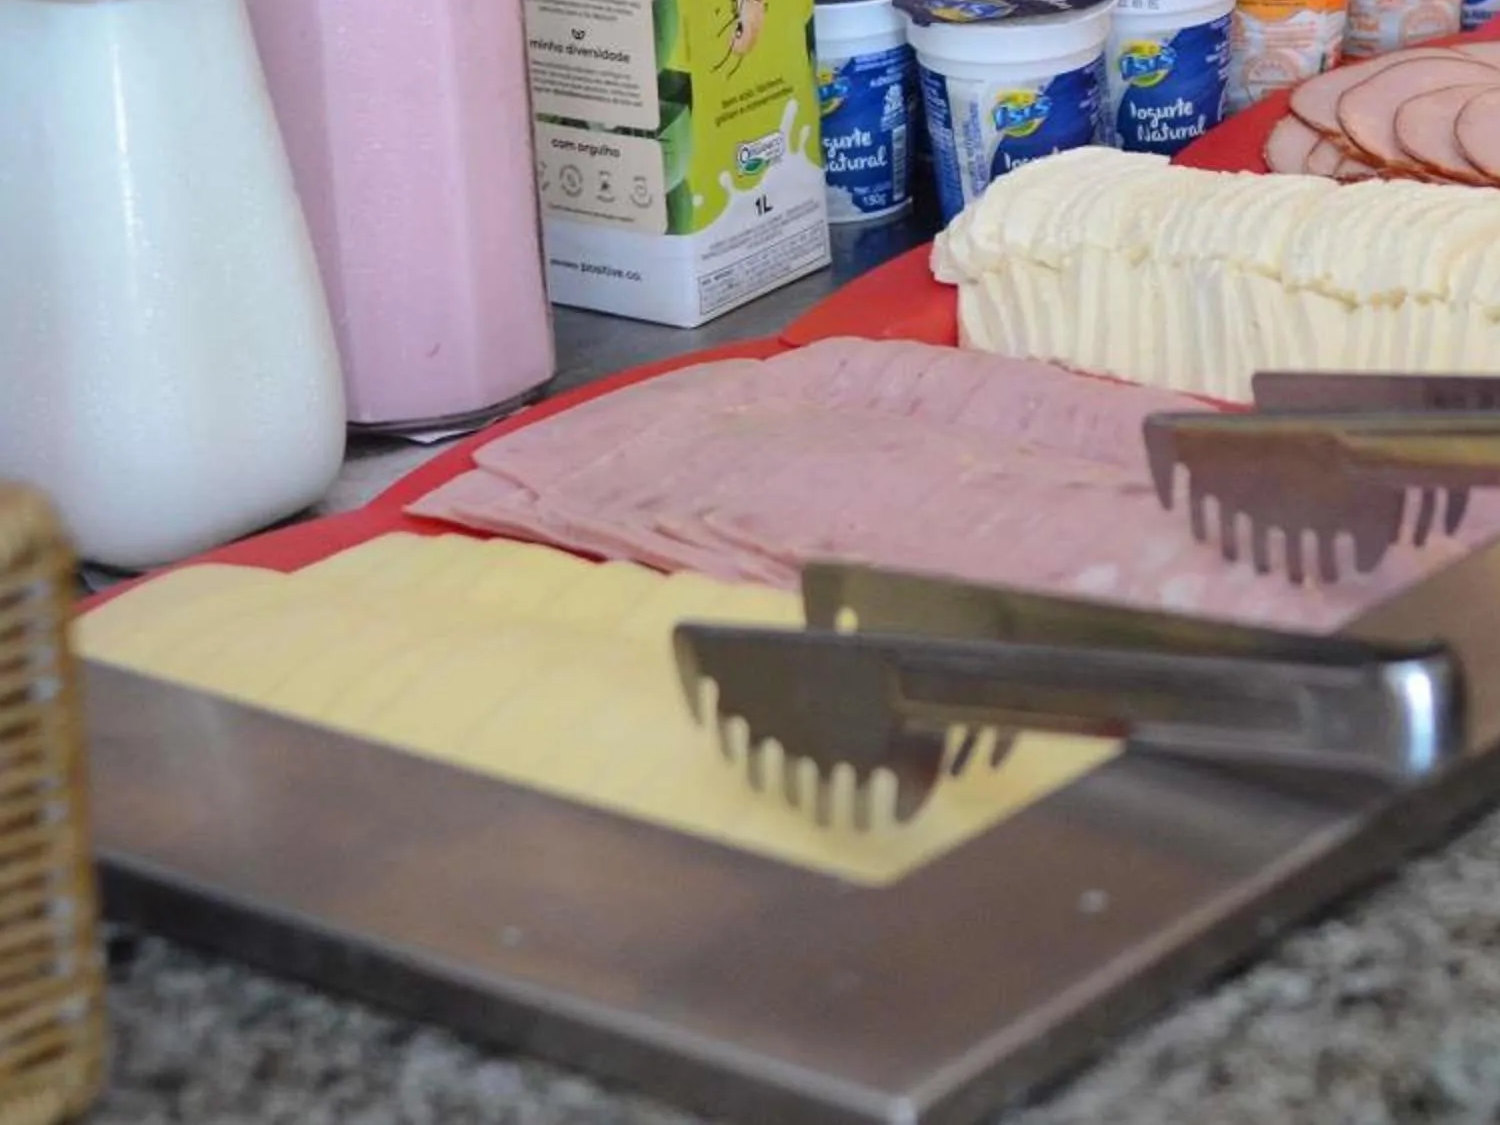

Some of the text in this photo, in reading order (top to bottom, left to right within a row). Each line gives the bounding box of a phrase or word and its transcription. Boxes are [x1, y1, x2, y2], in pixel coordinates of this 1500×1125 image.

[529, 38, 563, 54] minha
[1130, 97, 1194, 127] Iogurte
[1137, 114, 1208, 142] Natural
[550, 138, 621, 158] com orgulho
[755, 194, 774, 216] 1L
